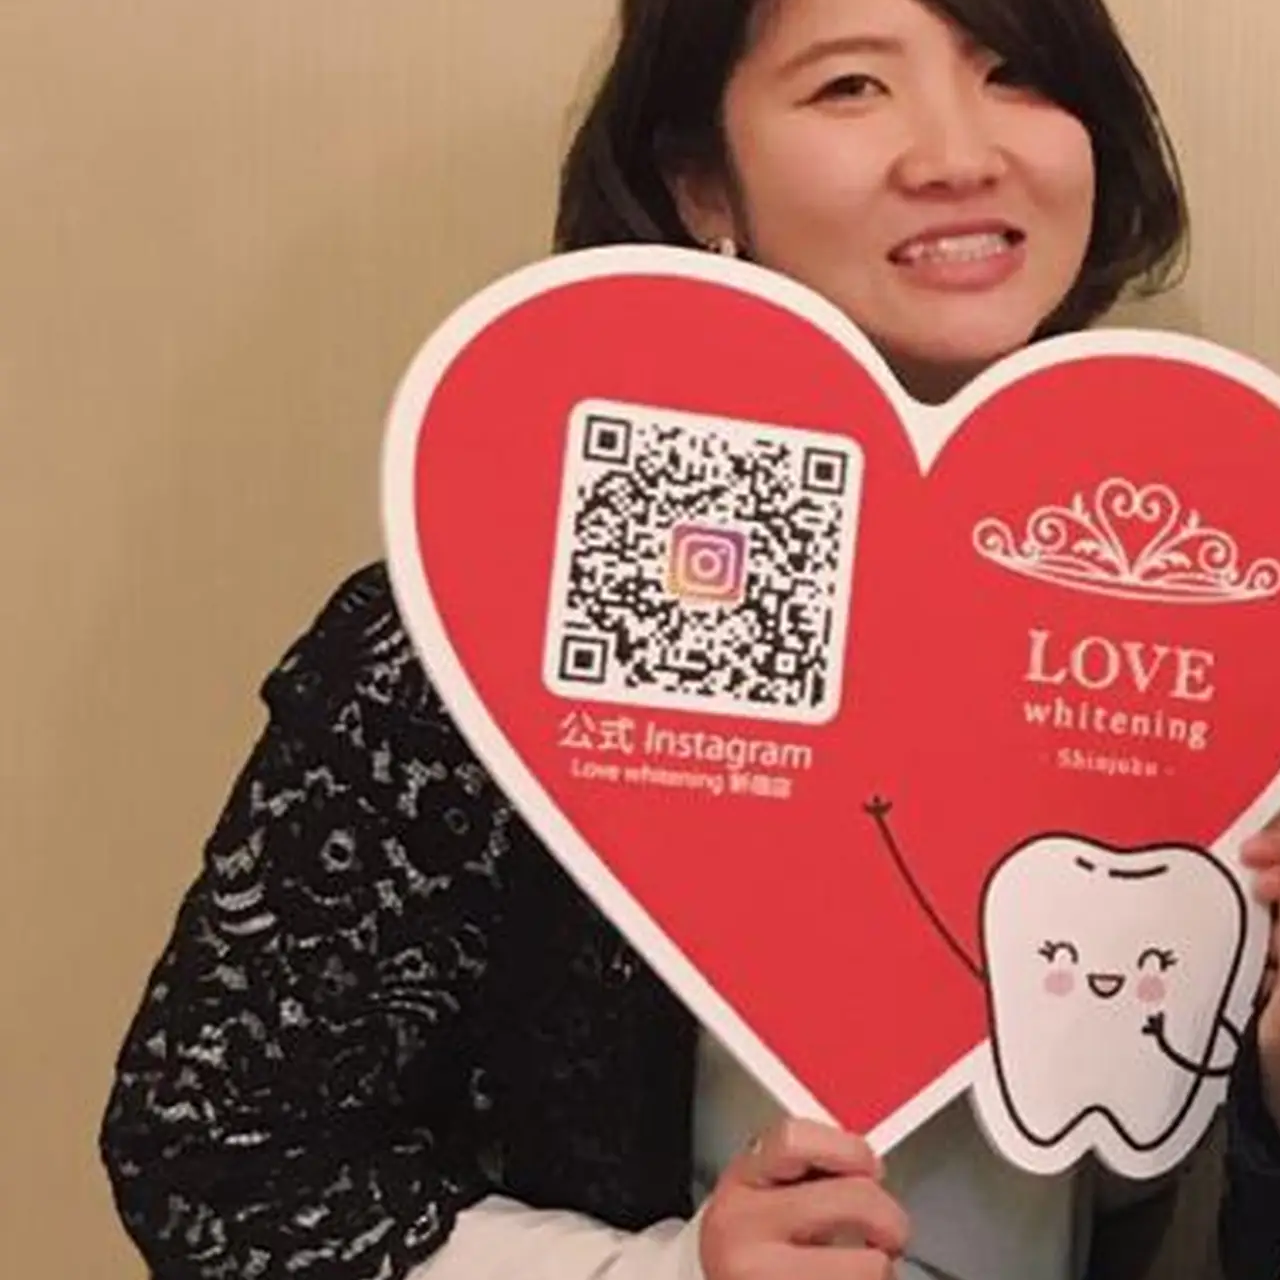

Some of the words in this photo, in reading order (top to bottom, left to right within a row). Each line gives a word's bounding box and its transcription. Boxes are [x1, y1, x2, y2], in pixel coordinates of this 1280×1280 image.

[1024, 628, 1216, 702] LOVE
[556, 711, 635, 754] 公式
[644, 721, 813, 770] Instagram
[1023, 697, 1209, 749] whitening
[571, 757, 619, 782] Love
